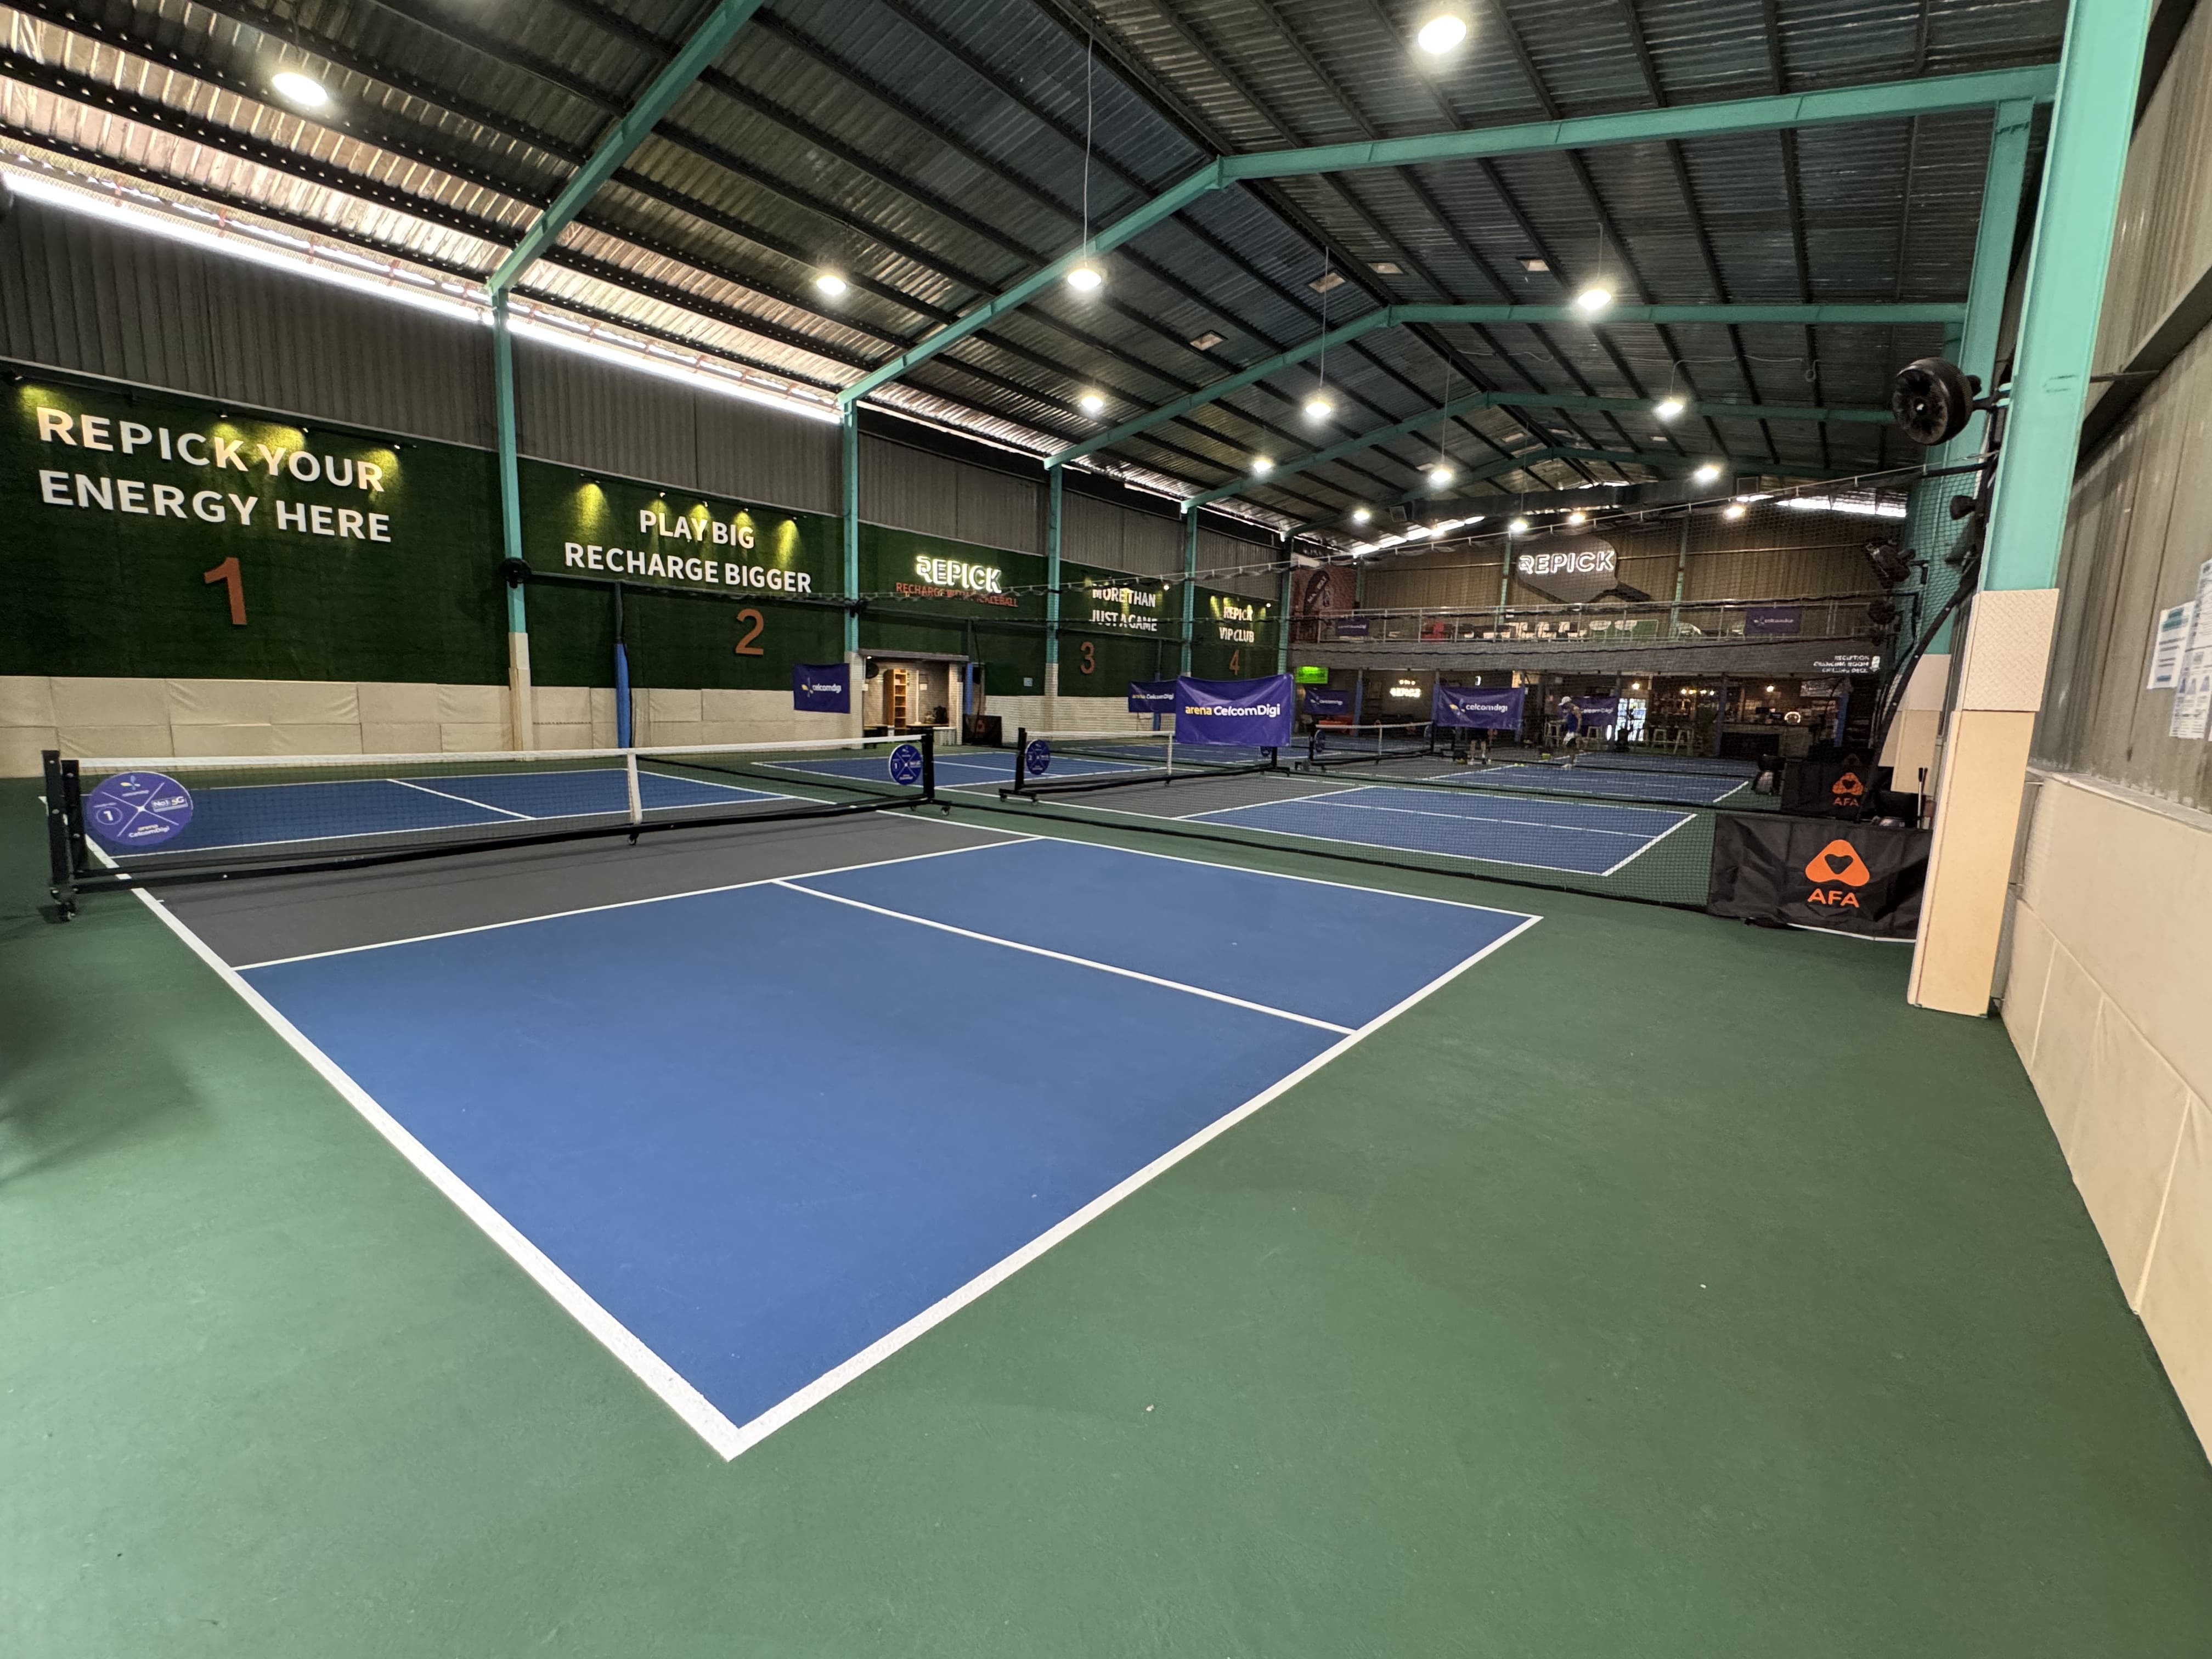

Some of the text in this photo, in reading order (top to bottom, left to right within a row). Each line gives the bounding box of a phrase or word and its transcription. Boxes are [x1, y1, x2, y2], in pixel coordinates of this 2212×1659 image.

[36, 406, 385, 492] REPICK YOUR
[39, 469, 392, 543] ENERGY HERE
[639, 510, 755, 549] PLAY BIG
[565, 542, 811, 593] RECHARGE BIGGER
[916, 555, 1002, 594] REPICK
[1519, 550, 1615, 575] REPICK
[204, 557, 247, 625] 1
[1092, 584, 1156, 607] MORE THAN
[1088, 610, 1158, 631] JUST A GAME
[1223, 606, 1254, 622] REPICK
[735, 608, 764, 656] 2
[1219, 627, 1255, 643] VIP CLUB
[1080, 641, 1095, 674] 3
[1229, 649, 1240, 676] 4
[1185, 703, 1281, 718] arena CelcomDigi
[1833, 797, 1860, 806] AFA
[103, 810, 114, 821] 1
[1807, 888, 1860, 908] AFA
